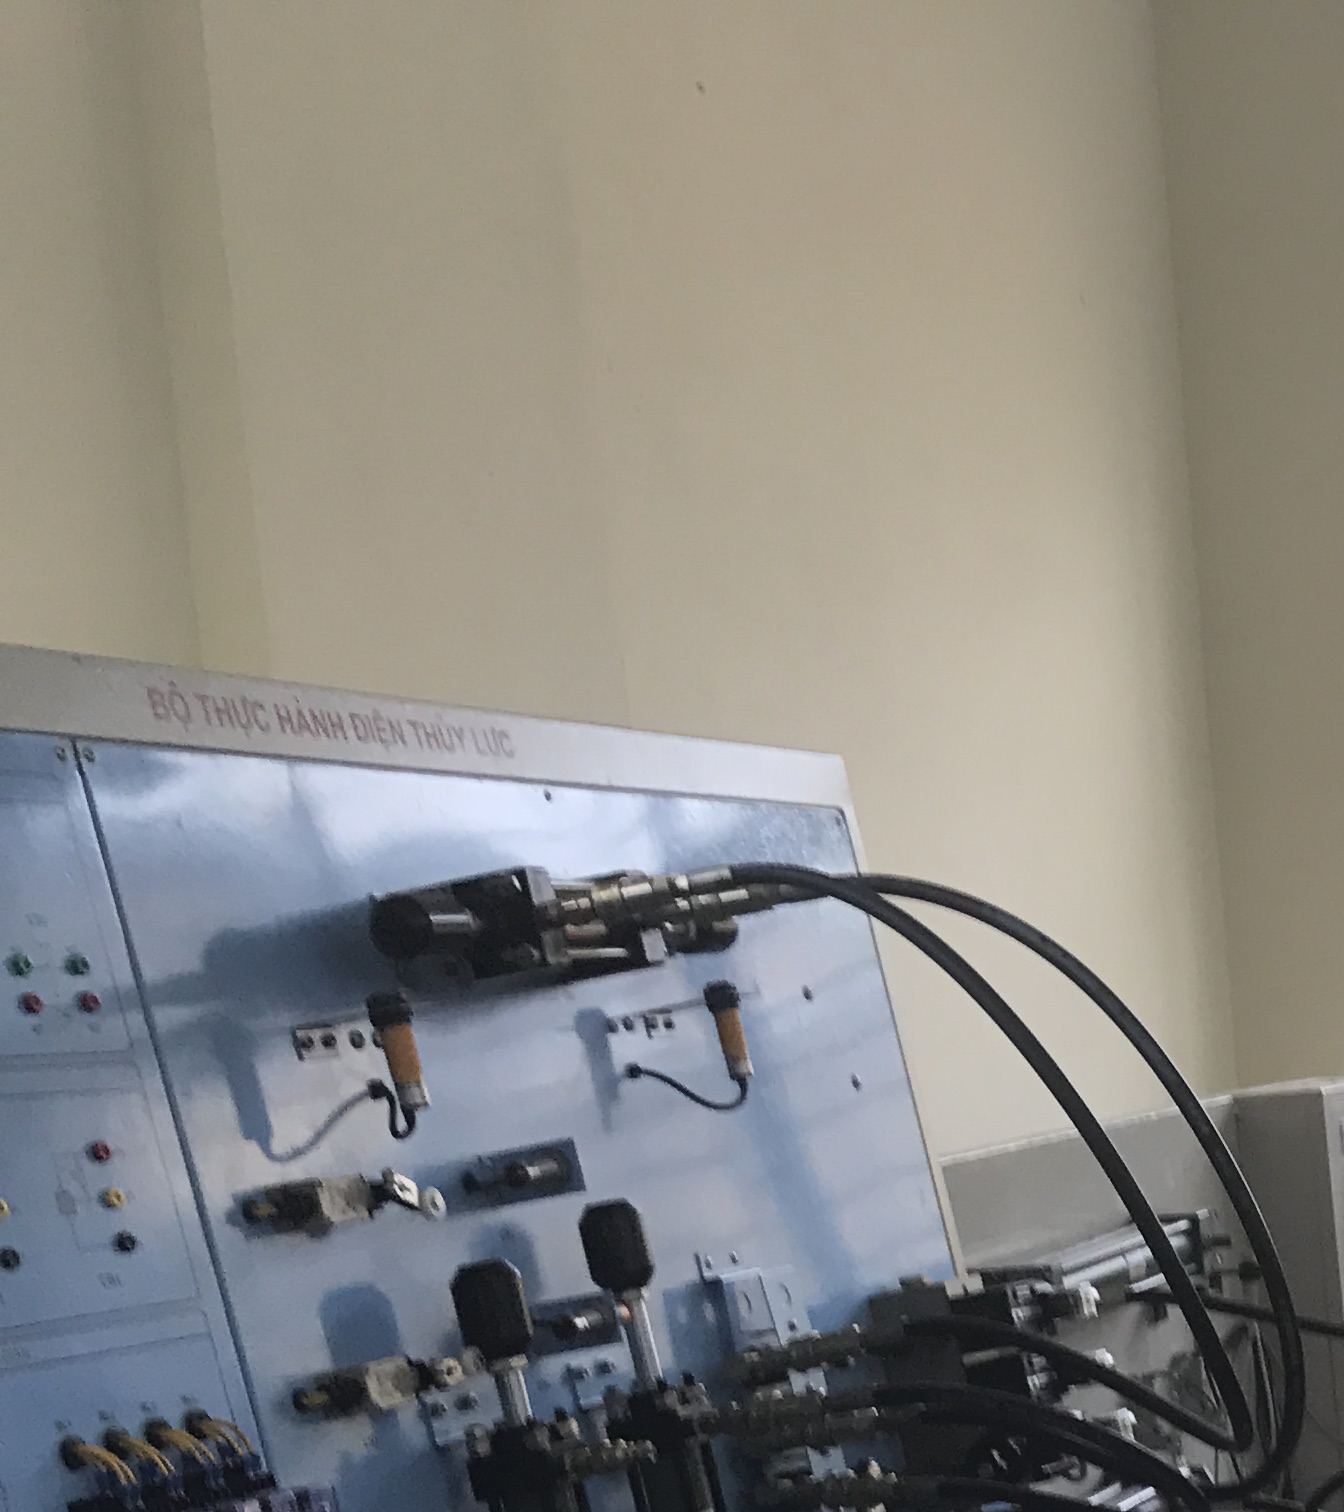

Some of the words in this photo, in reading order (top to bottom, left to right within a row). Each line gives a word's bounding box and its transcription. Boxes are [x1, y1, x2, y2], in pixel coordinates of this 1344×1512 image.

[147, 680, 190, 733] BỘ
[193, 693, 270, 739] THỰC
[273, 694, 348, 741] HÀNH
